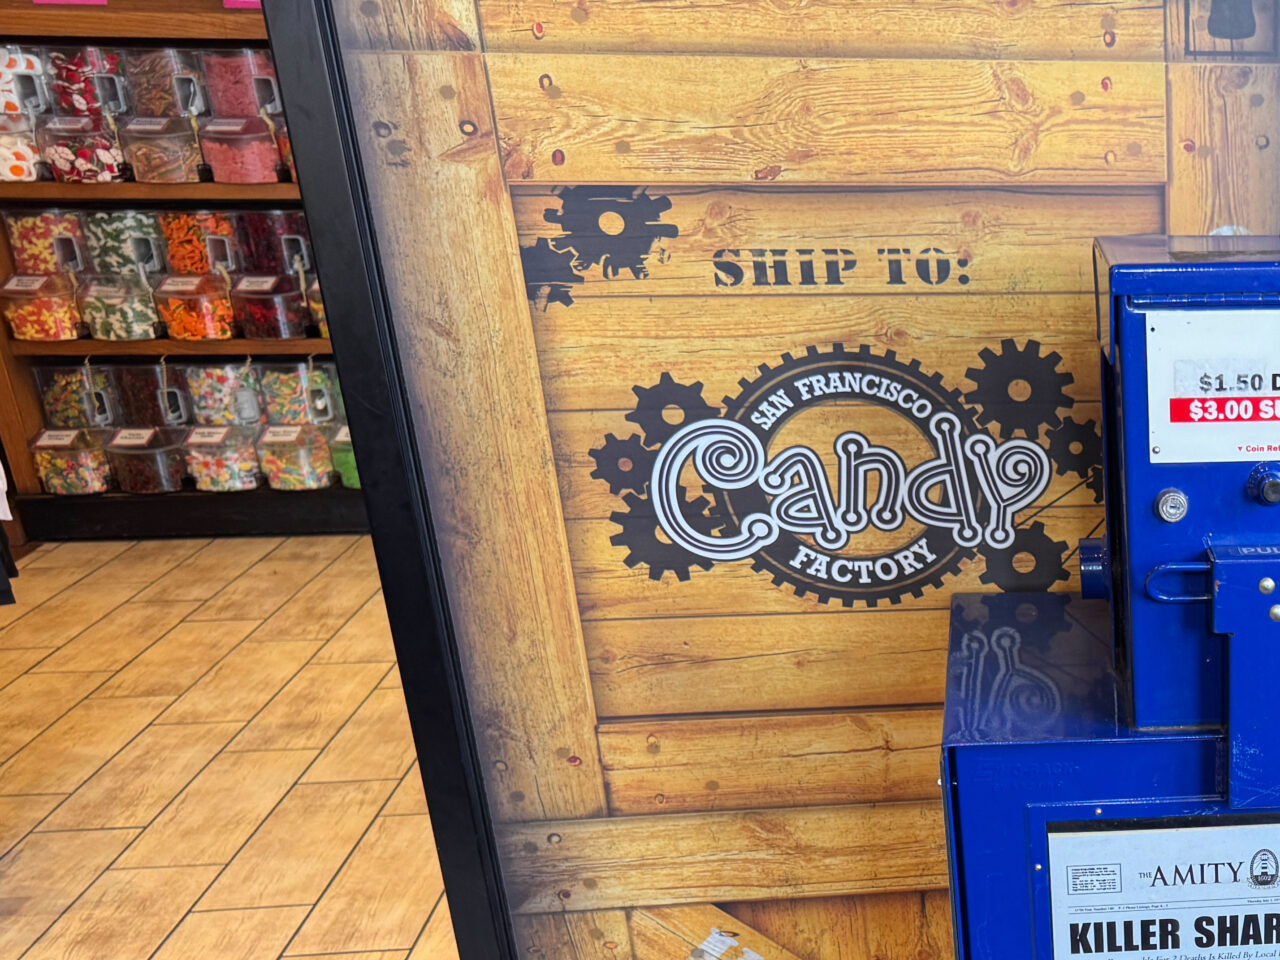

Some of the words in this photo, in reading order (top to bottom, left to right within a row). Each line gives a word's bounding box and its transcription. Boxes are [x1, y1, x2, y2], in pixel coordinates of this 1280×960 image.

[712, 248, 858, 287] SHIP
[877, 247, 972, 287] TO:
[1199, 373, 1264, 392] $1.50
[750, 389, 793, 431] SAN
[794, 371, 932, 419] FRANCISCO
[1189, 399, 1253, 421] $3.00
[651, 410, 1050, 560] Candy
[789, 537, 937, 584] FACTORY
[1138, 871, 1152, 879] THE
[1150, 861, 1245, 887] AMITY
[1069, 918, 1180, 954] KILLER
[1217, 951, 1241, 960] Killed
[1242, 951, 1254, 960] By
[1255, 949, 1276, 958] Local
